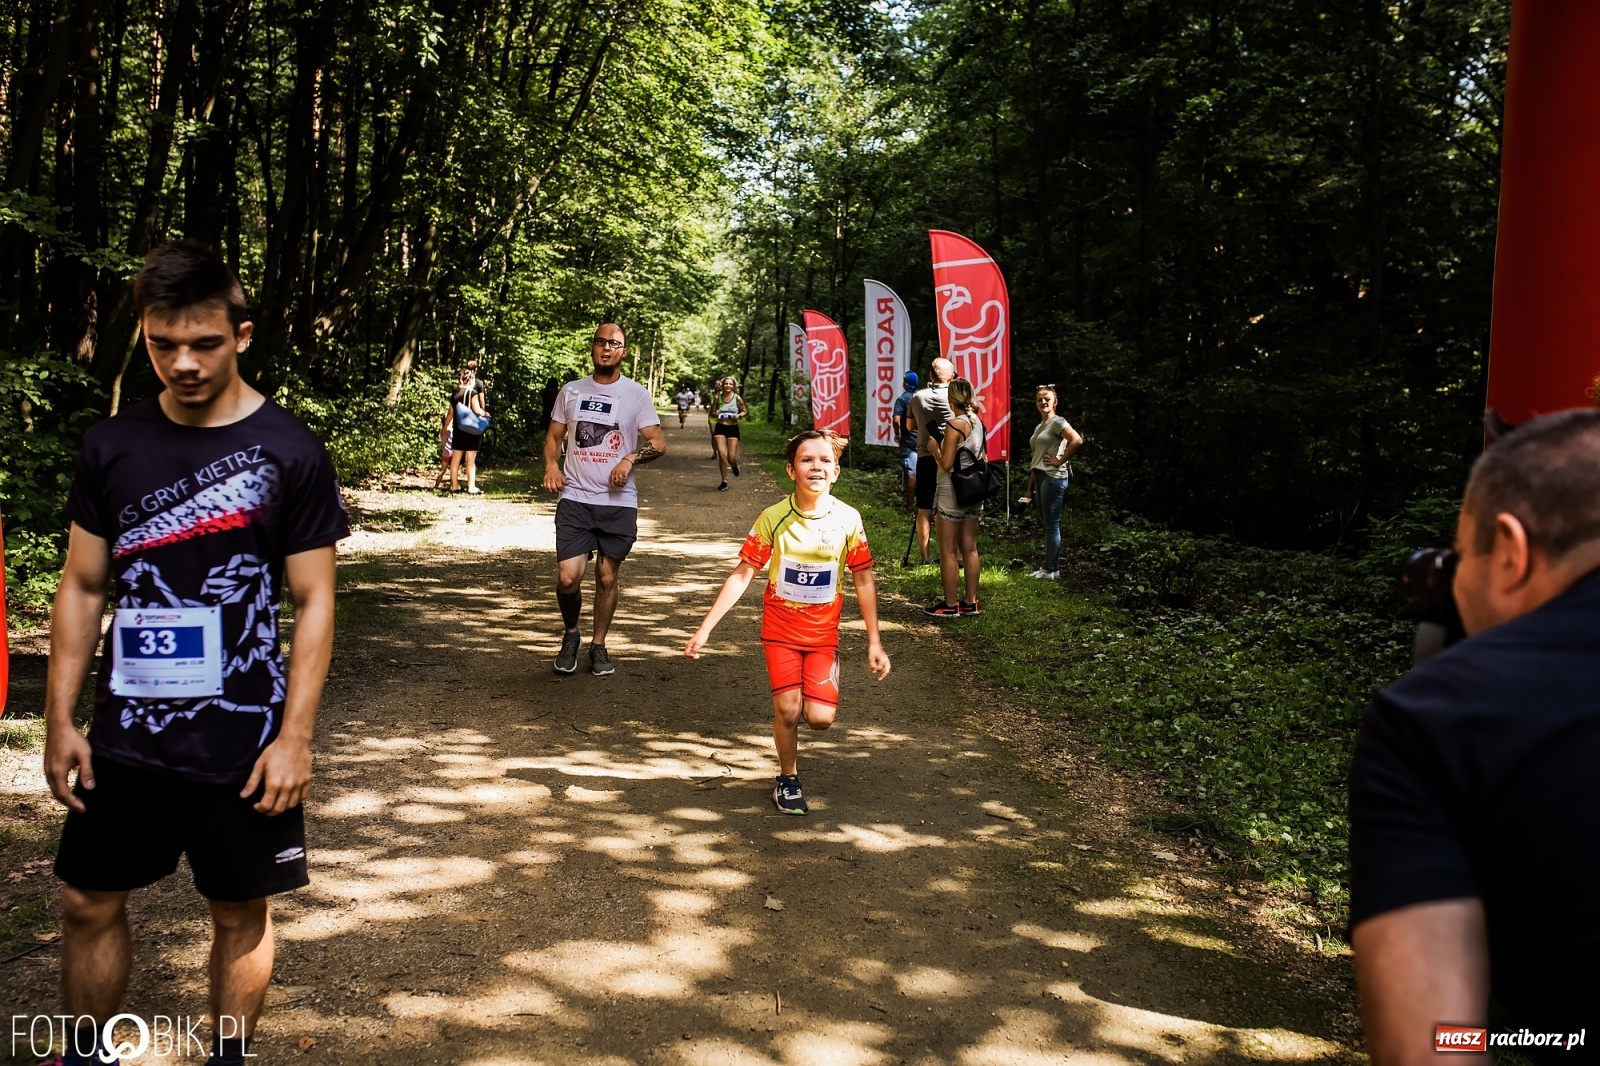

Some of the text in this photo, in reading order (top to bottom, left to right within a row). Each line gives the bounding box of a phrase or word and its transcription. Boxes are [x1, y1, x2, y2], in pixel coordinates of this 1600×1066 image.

[588, 402, 603, 411] 52
[117, 444, 267, 528] KS GRYF KIETRZ
[797, 572, 819, 585] 87
[138, 629, 178, 655] 33
